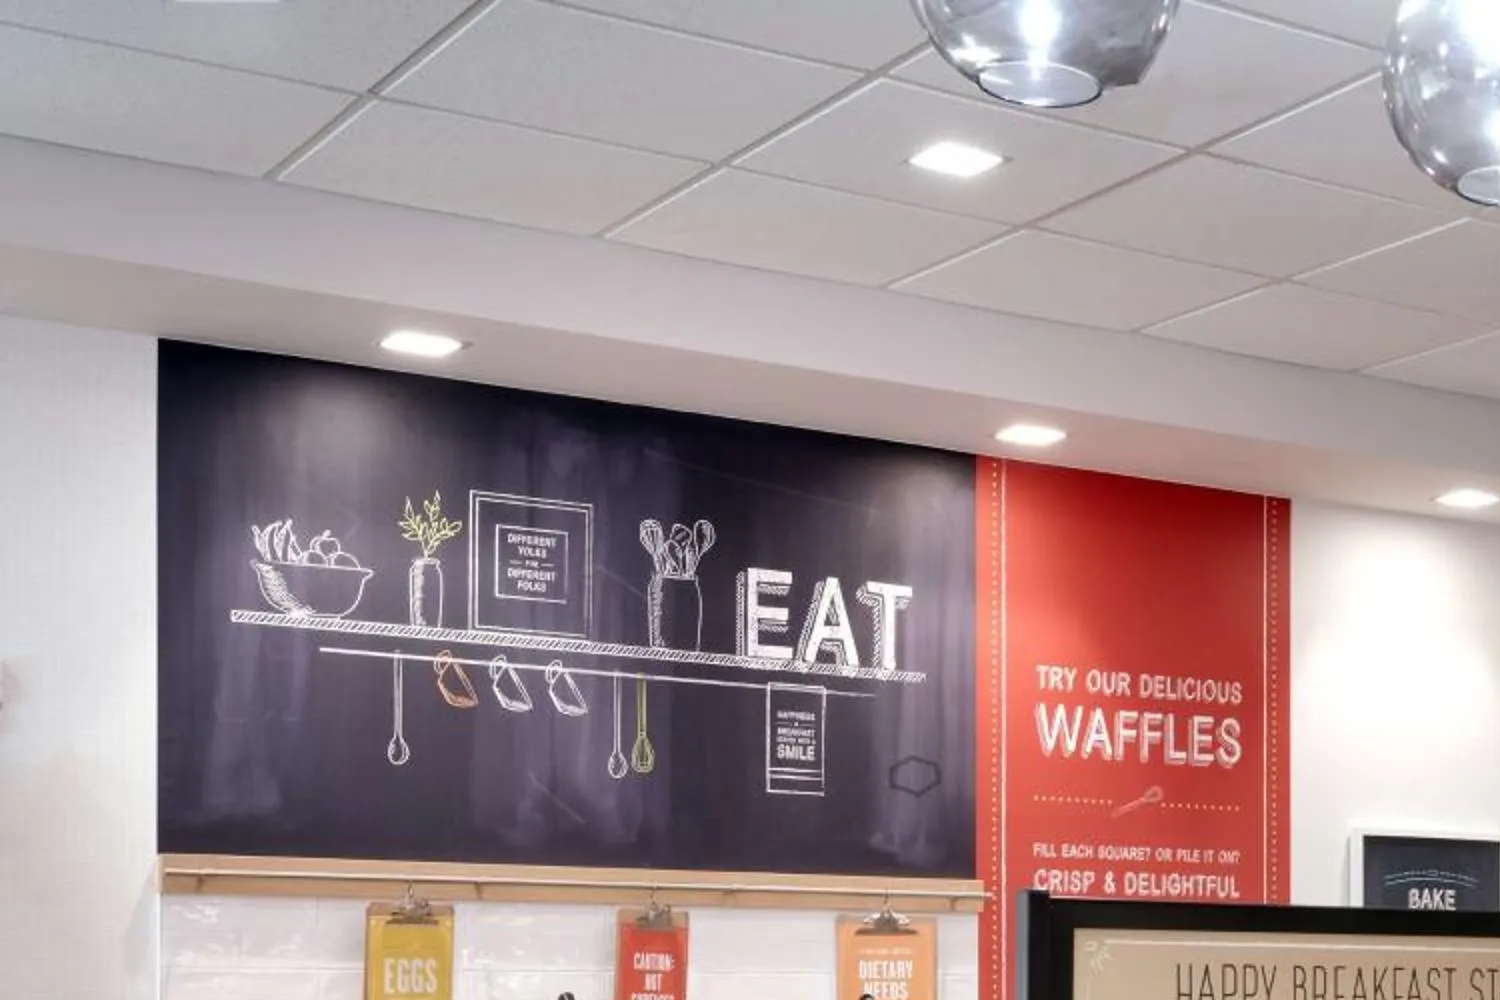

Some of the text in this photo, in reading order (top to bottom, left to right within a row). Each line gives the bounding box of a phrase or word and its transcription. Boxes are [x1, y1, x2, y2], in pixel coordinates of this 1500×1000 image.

[507, 533, 556, 547] DIFFERENT
[518, 546, 547, 558] YOLKS
[507, 568, 556, 582] DIFFERENT
[517, 580, 547, 593] FOLKS
[737, 567, 913, 671] EAT
[1036, 664, 1243, 705] TRY OUR DELICIOUS
[1034, 702, 1243, 768] WAFFLES
[776, 743, 816, 761] SMILE
[1032, 842, 1057, 858] FILL
[1061, 844, 1093, 859] EACH
[1098, 846, 1151, 861] SQUARE?
[1155, 847, 1173, 862] OR
[1176, 848, 1199, 863] PILE
[1203, 849, 1214, 864] IT
[1034, 869, 1240, 898] CRISP & DELIGHTFUL
[1408, 887, 1457, 911] BAKE
[383, 957, 438, 995] EGGS
[858, 959, 914, 979] DIETARY
[863, 981, 909, 1000] NEEDS
